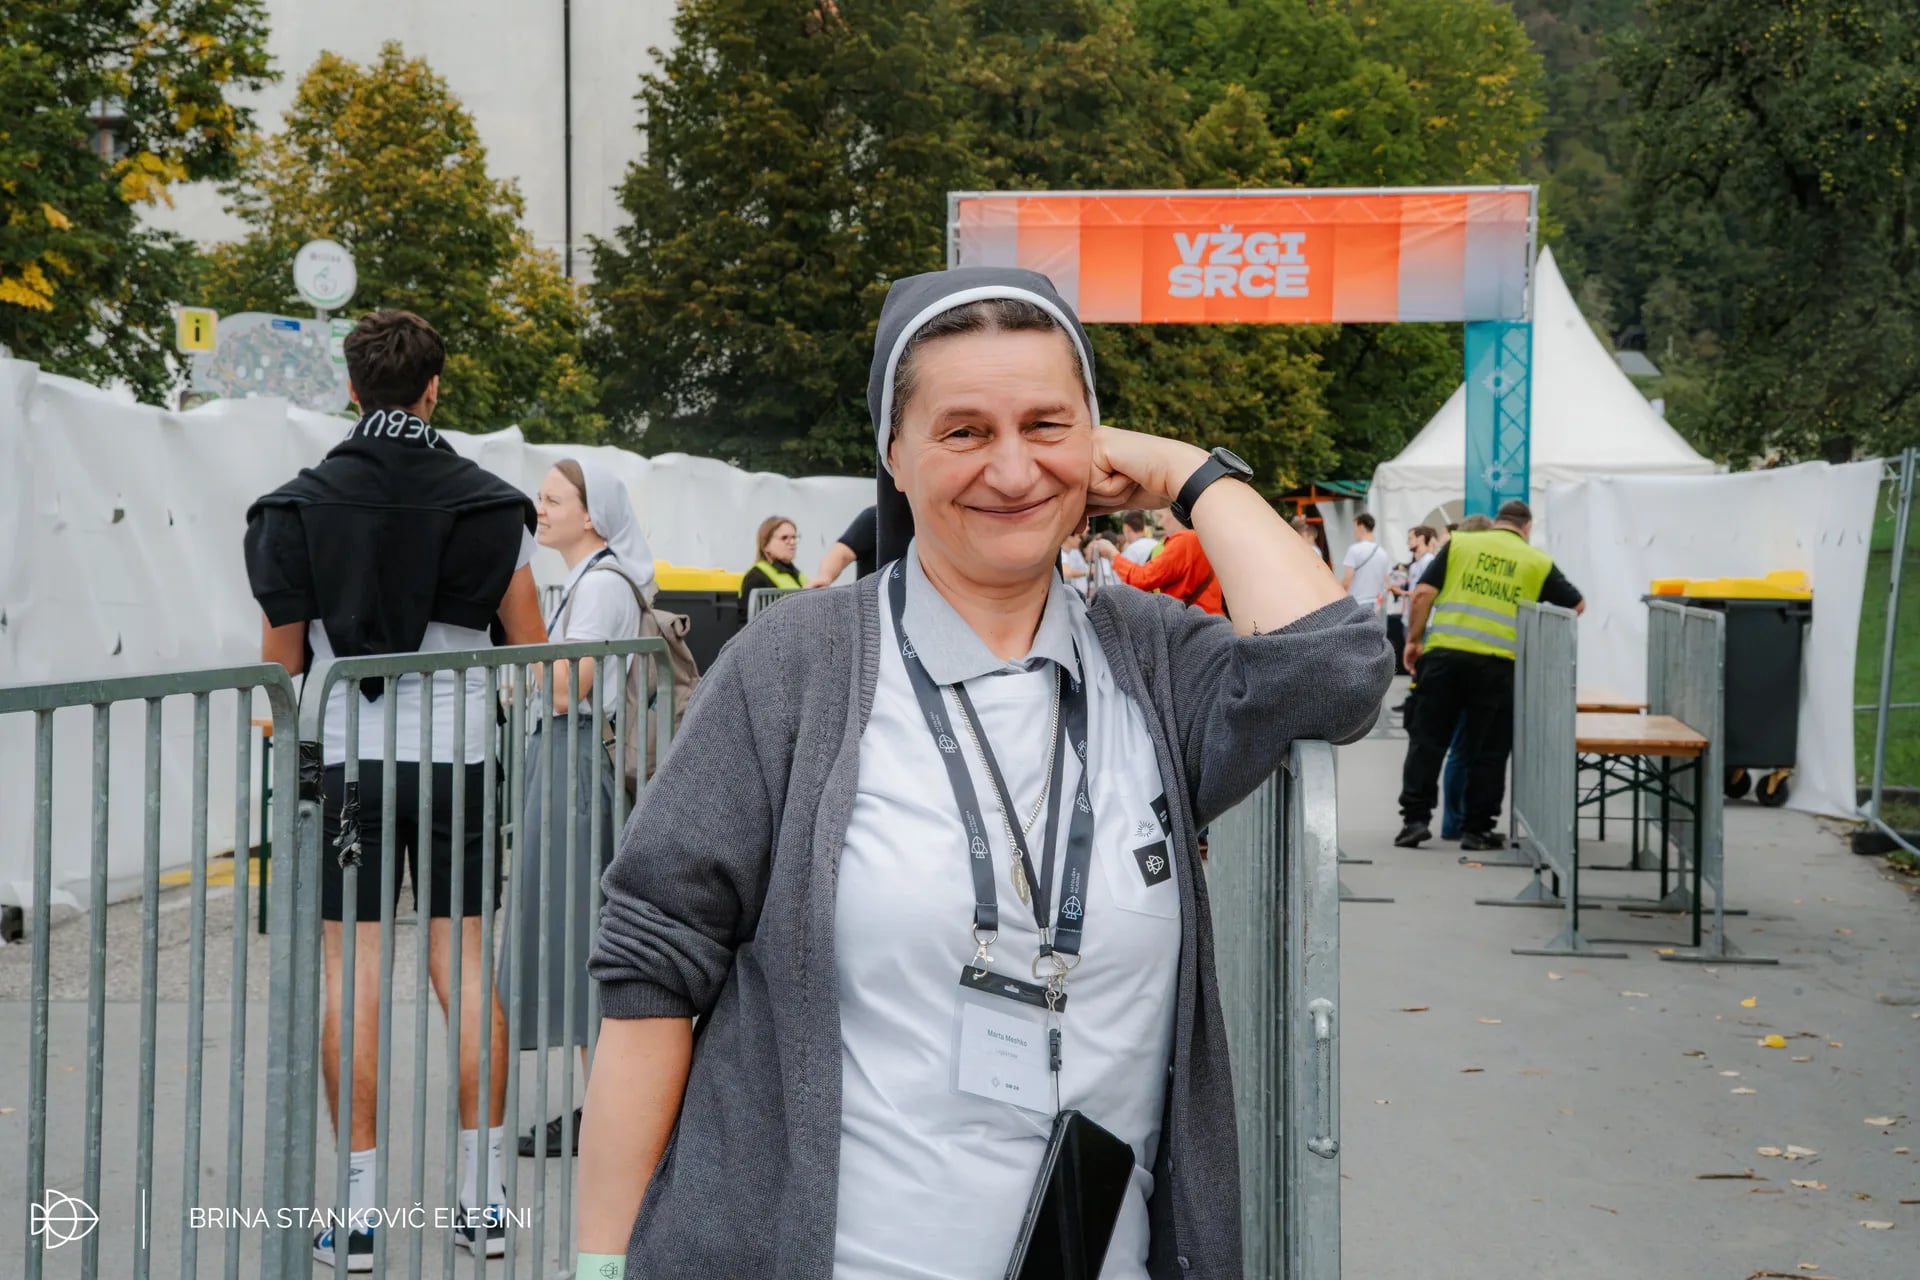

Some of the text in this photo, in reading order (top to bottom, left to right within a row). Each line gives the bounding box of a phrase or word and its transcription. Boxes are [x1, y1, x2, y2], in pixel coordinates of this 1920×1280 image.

[1173, 224, 1306, 265] VŽGI
[1168, 264, 1309, 298] SRCE
[1477, 552, 1517, 578] FORTIM
[1461, 573, 1522, 605] VAROVANJE
